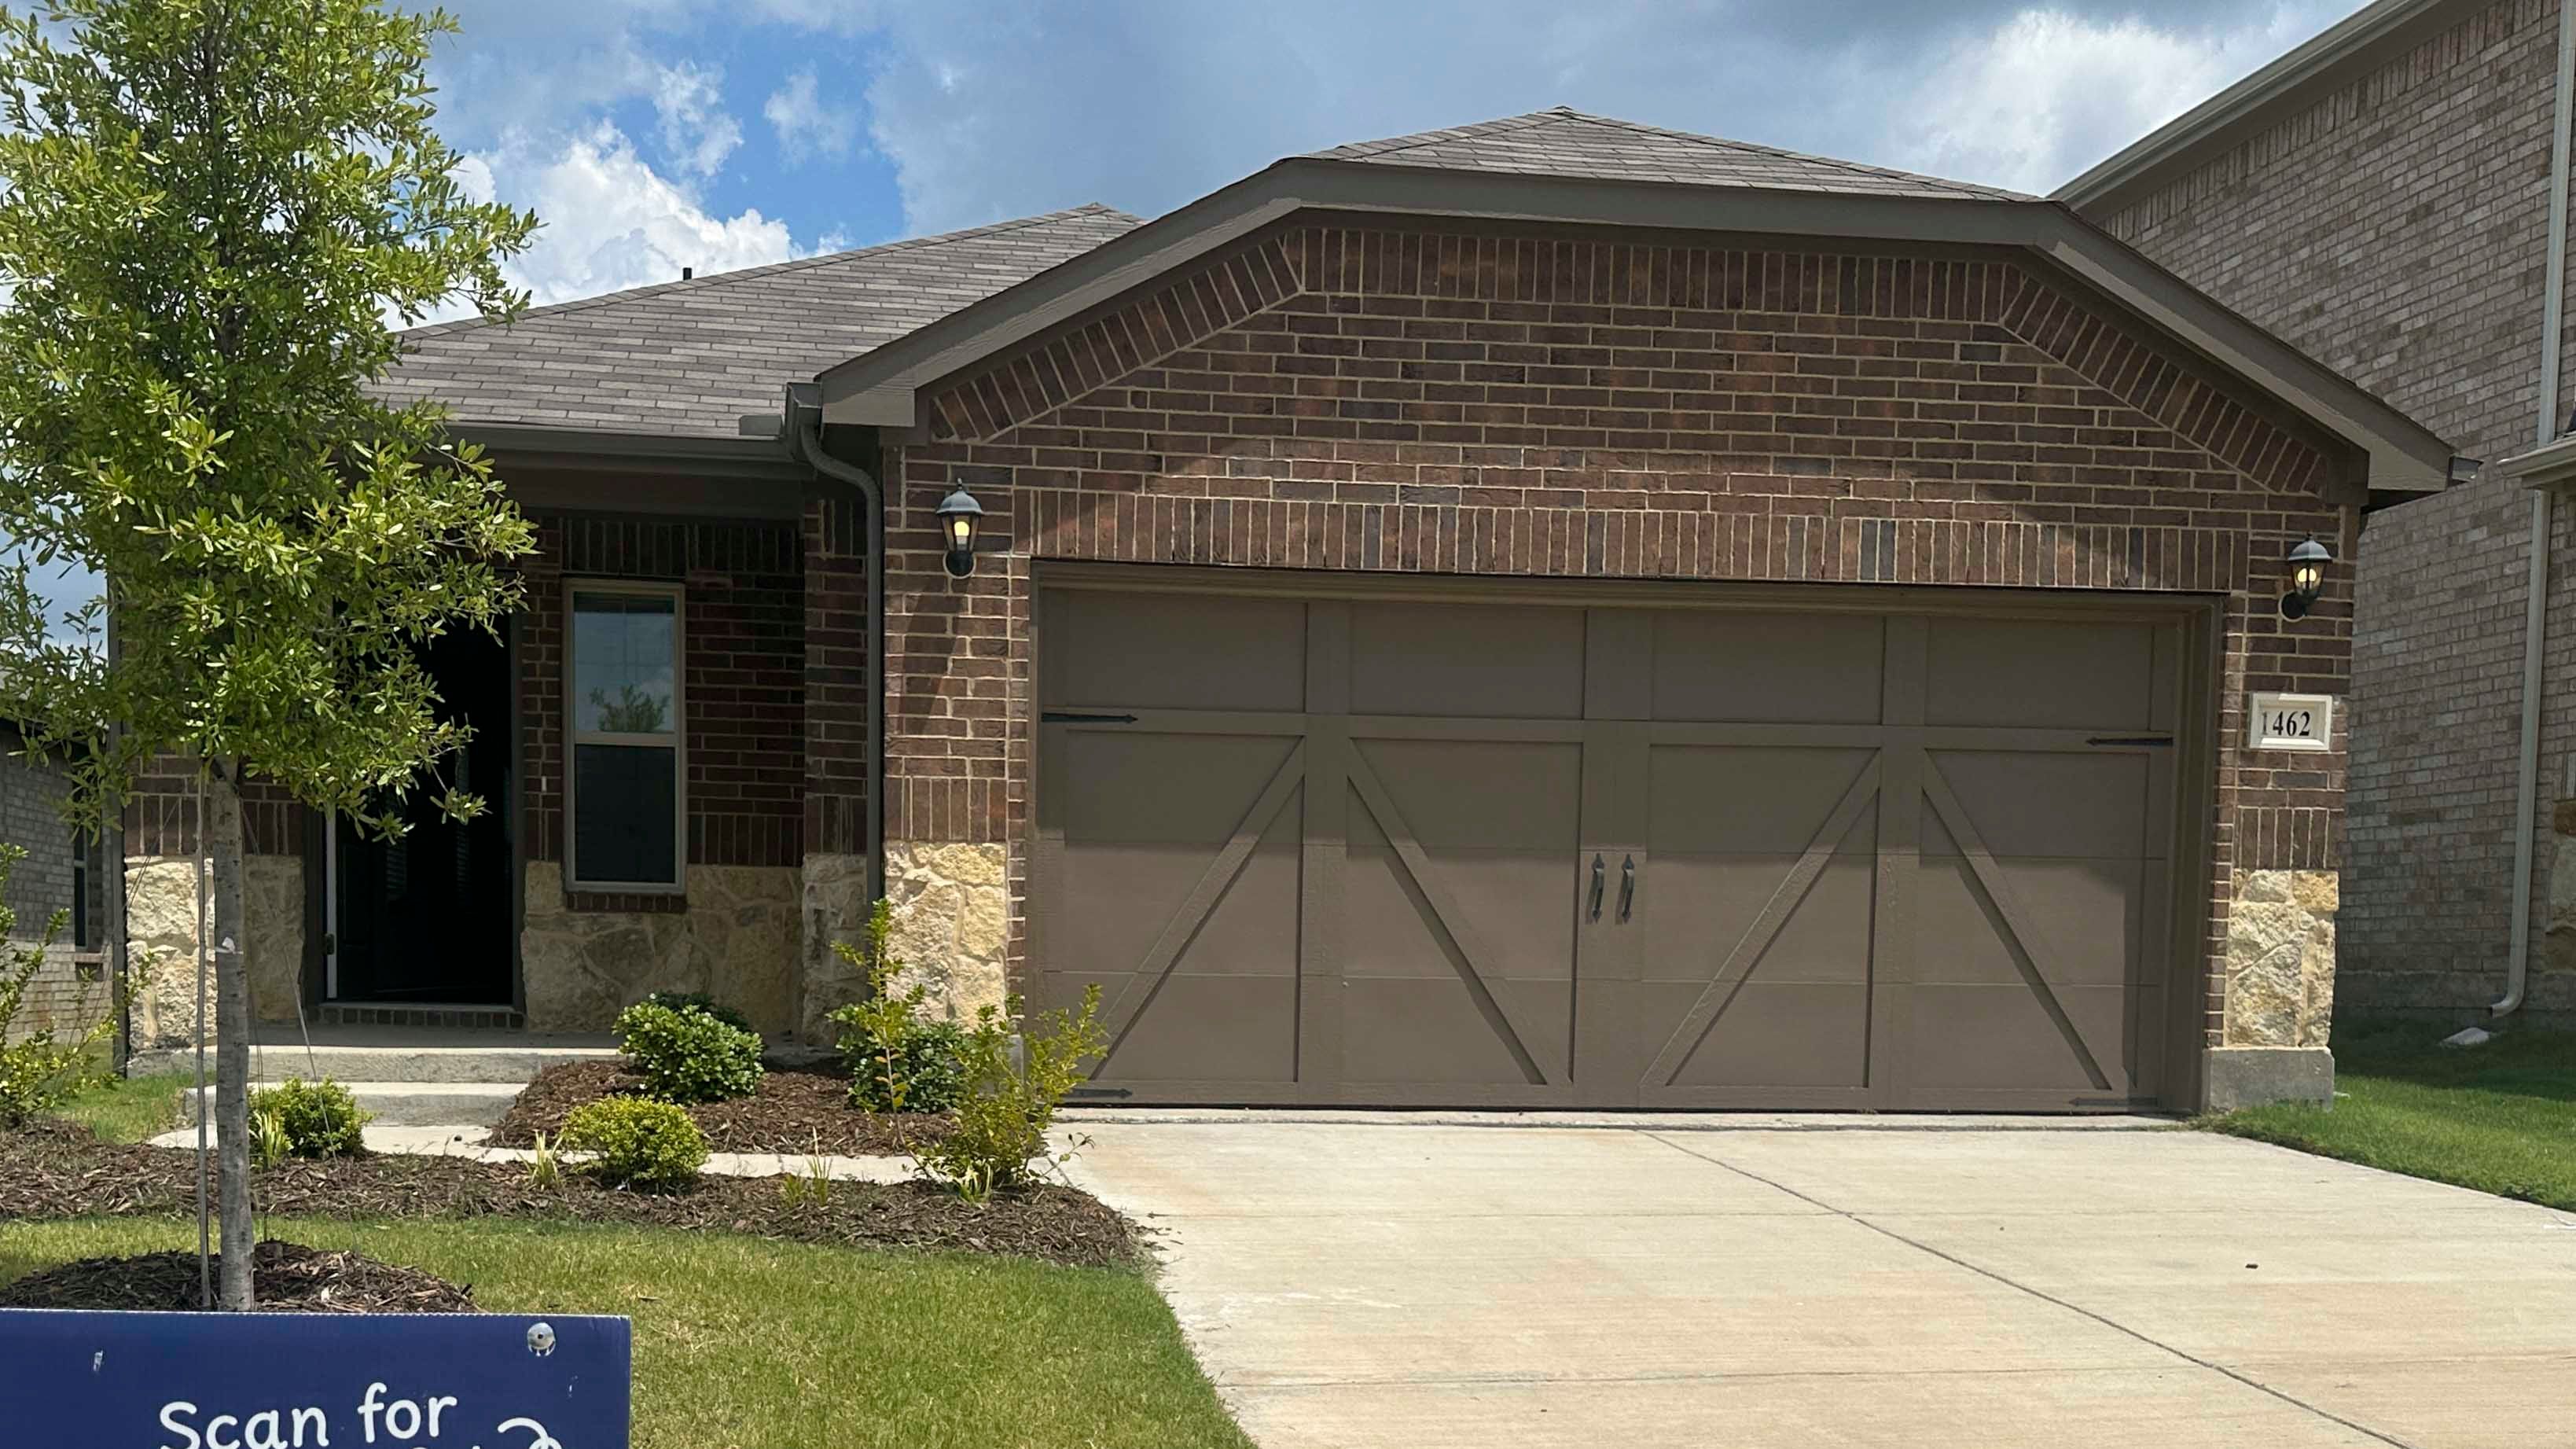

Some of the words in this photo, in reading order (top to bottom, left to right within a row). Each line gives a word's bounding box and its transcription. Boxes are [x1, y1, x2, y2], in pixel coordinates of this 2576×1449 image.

[2262, 711, 2311, 737] 1462
[159, 1401, 329, 1449] Scan
[357, 1381, 458, 1443] for
